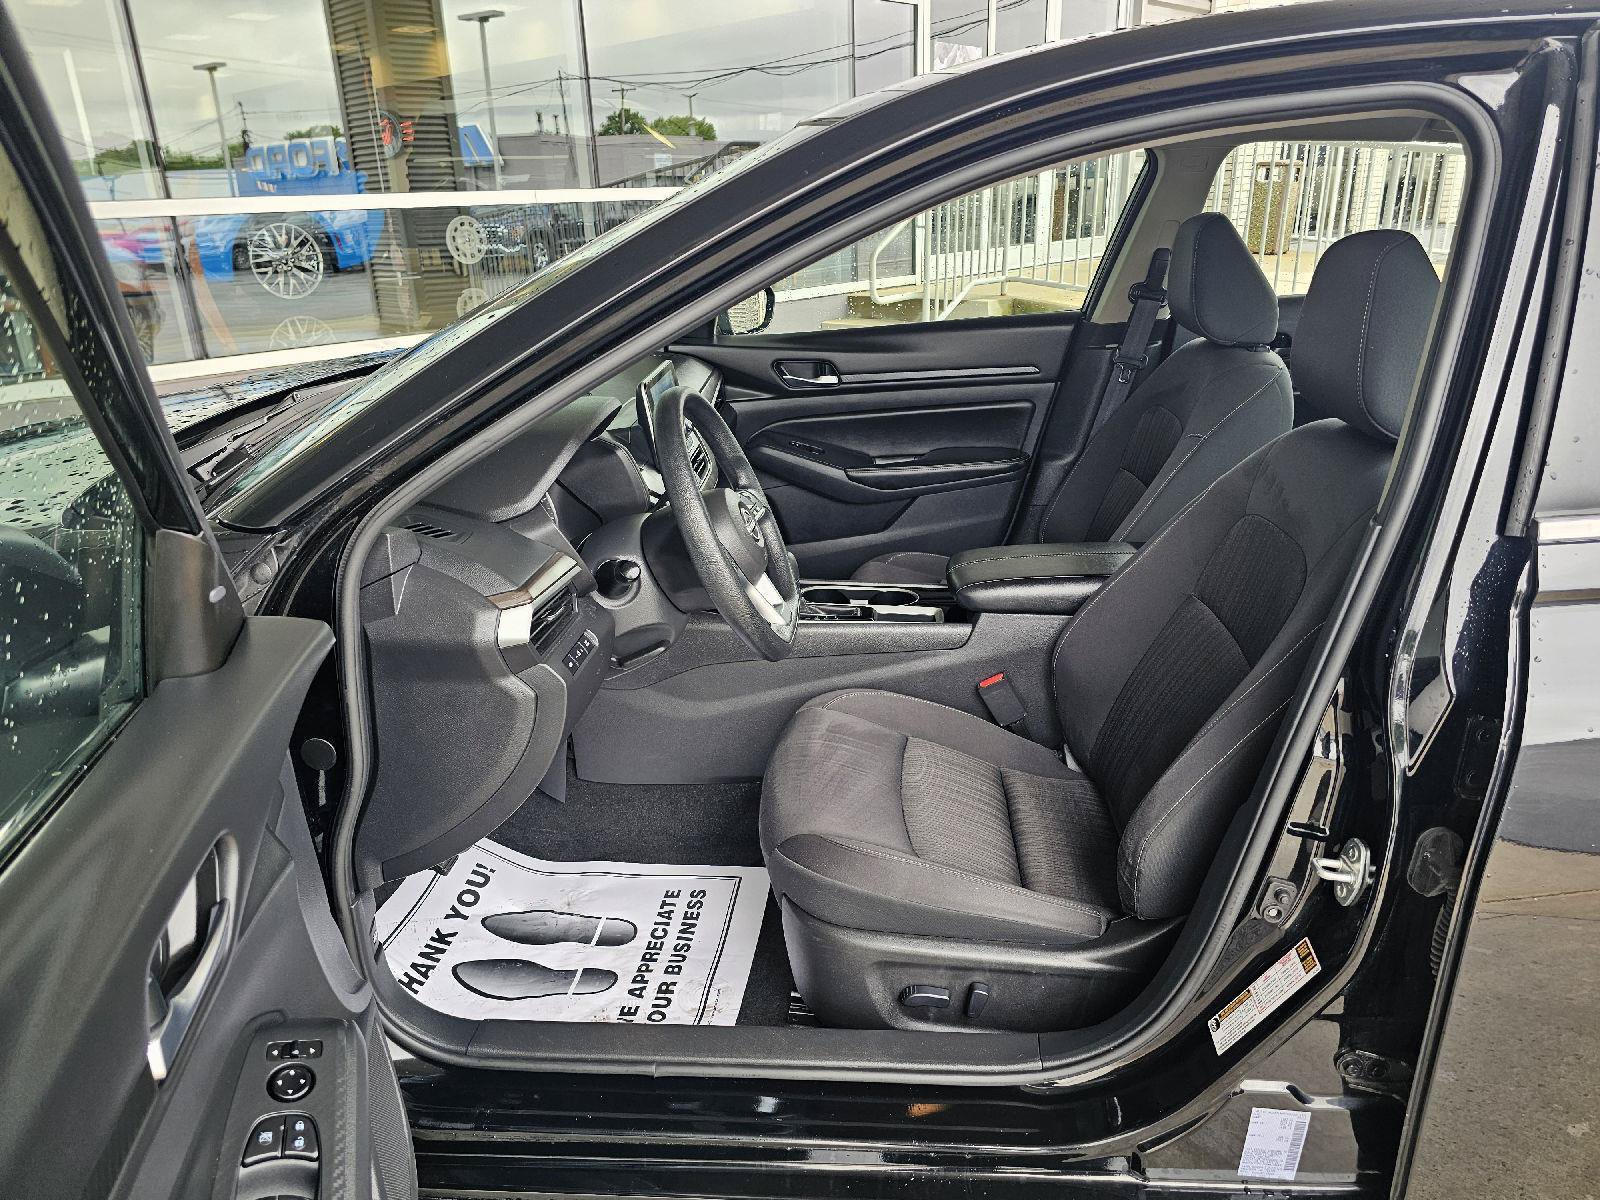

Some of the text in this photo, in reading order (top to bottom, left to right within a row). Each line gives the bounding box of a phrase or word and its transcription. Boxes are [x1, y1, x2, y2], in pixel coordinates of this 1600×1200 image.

[398, 862, 496, 995] HANK YOU!
[628, 890, 681, 999] APPRECIATE
[647, 889, 706, 1022] OUR BUSINESS
